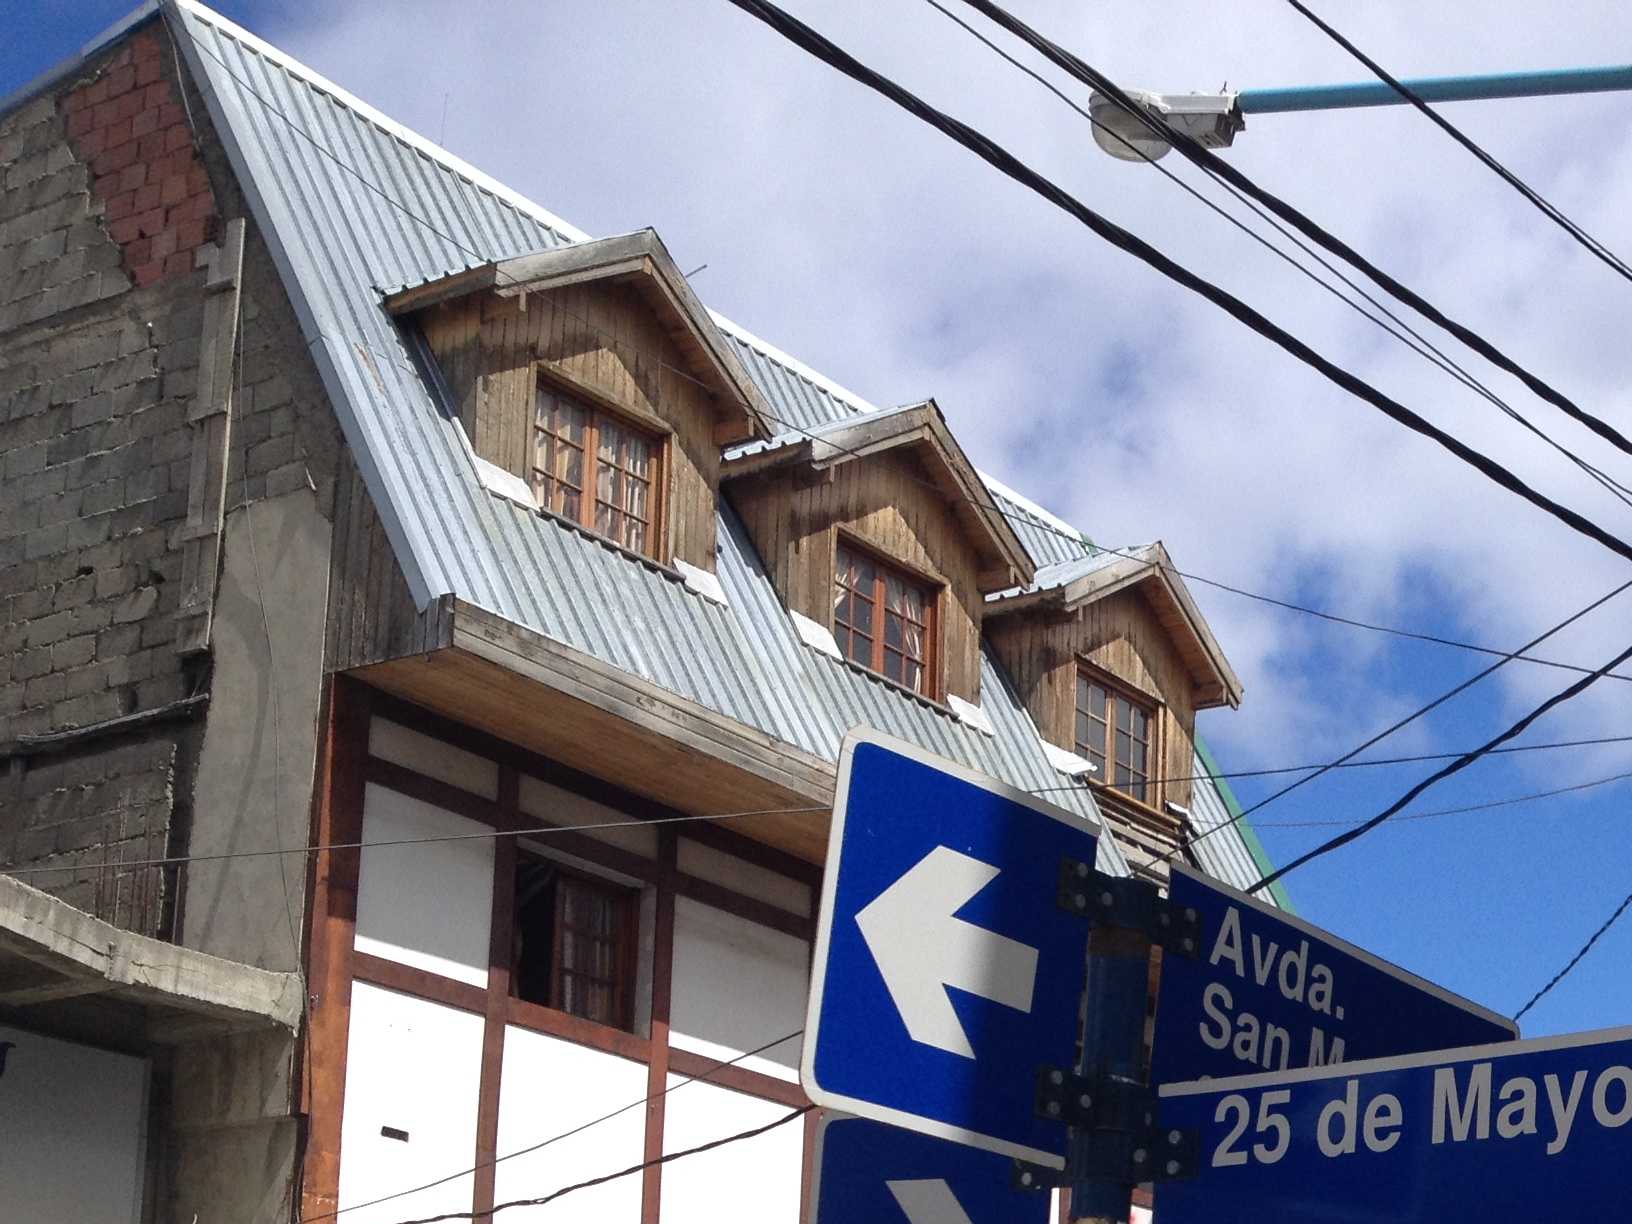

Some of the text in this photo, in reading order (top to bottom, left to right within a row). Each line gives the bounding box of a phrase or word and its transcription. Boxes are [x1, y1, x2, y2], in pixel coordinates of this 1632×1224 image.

[1209, 906, 1345, 1021] Avda.
[1199, 982, 1290, 1071] San
[1212, 1089, 1291, 1168] 25
[1317, 1079, 1402, 1158] de
